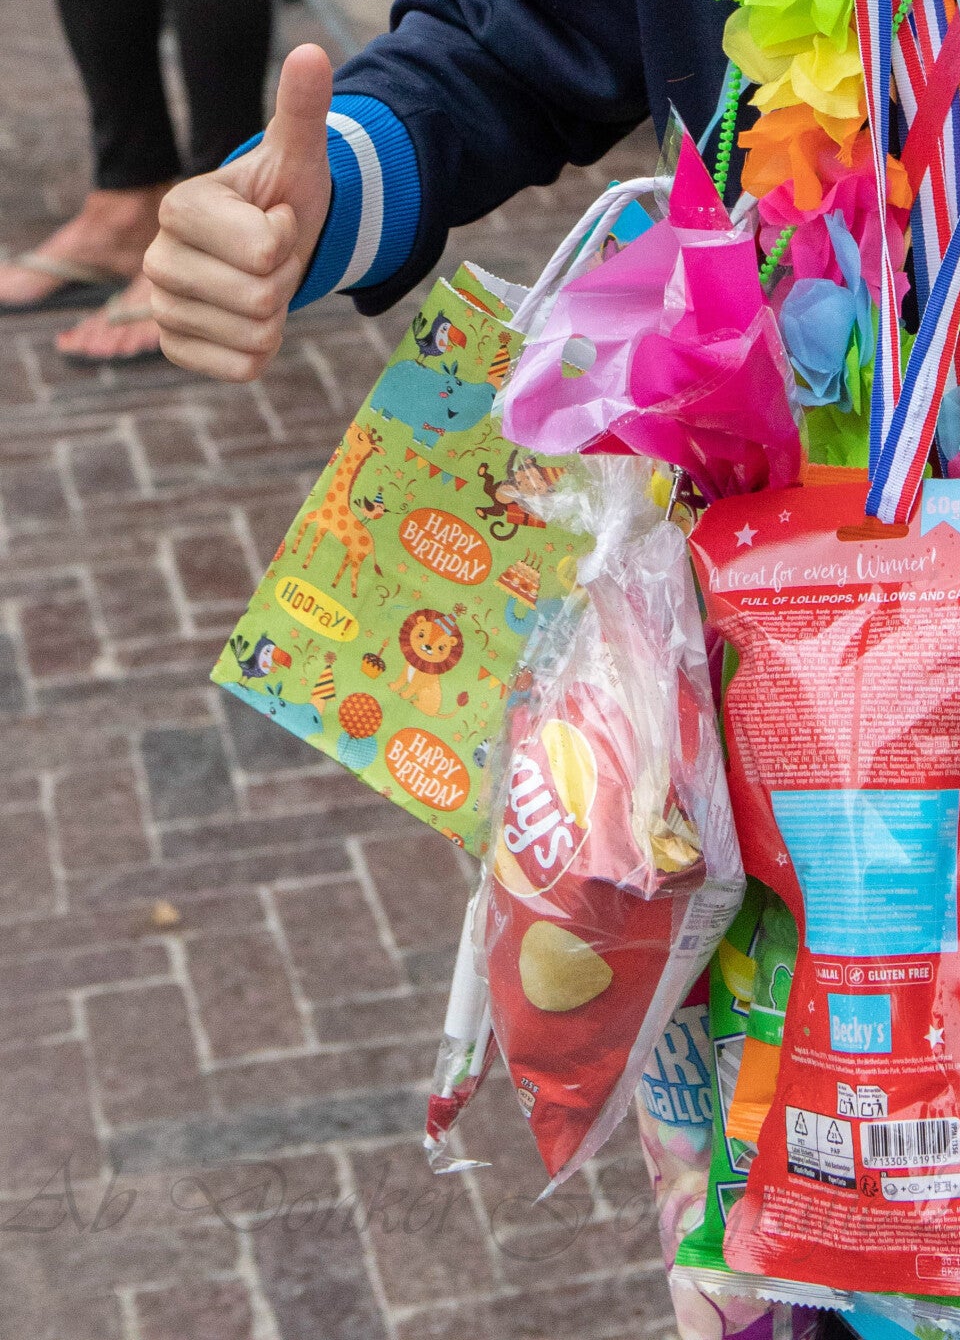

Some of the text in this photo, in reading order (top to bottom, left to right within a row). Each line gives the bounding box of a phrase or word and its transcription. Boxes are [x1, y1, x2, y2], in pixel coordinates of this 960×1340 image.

[403, 520, 487, 582] BIRTHDAY
[426, 513, 481, 554] HAPPY
[708, 547, 937, 593] A treat for every Winner!
[741, 597, 769, 607] FULL
[772, 596, 788, 606] OF
[790, 593, 856, 606] LOLLIPOPS,
[857, 591, 917, 604] MALLOWS
[919, 588, 949, 602] AND
[387, 740, 465, 809] BIRTHDAY
[410, 733, 461, 780] HAPPY
[506, 753, 576, 868] ay's
[868, 968, 929, 981] GLUTEN FREE
[832, 1016, 885, 1051] Becky's
[829, 1146, 841, 1155] PAP
[872, 1156, 908, 1166] 713305
[913, 1154, 948, 1165] 819155
